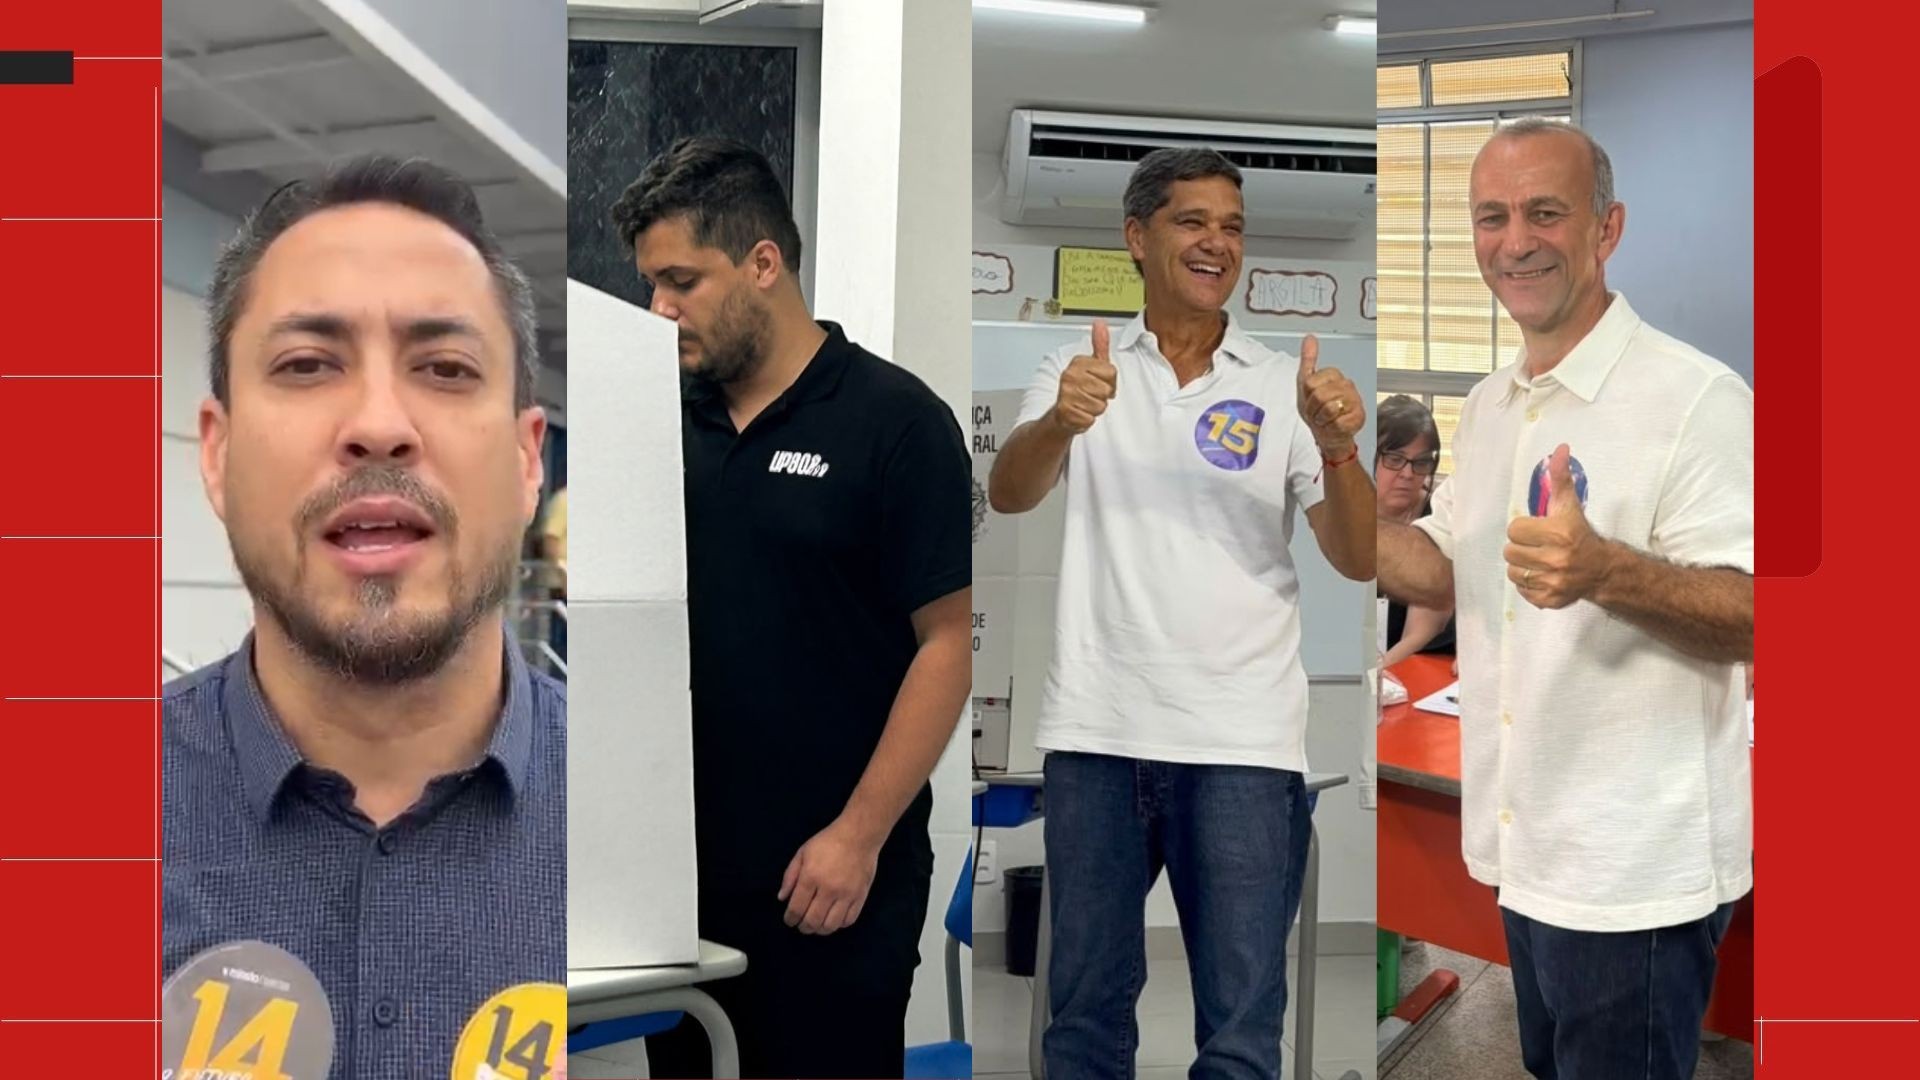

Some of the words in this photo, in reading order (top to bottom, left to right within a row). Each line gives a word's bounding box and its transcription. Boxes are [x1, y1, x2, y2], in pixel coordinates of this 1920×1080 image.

[1207, 412, 1260, 455] 15
[177, 979, 298, 1080] 14
[485, 1004, 552, 1080] 14
